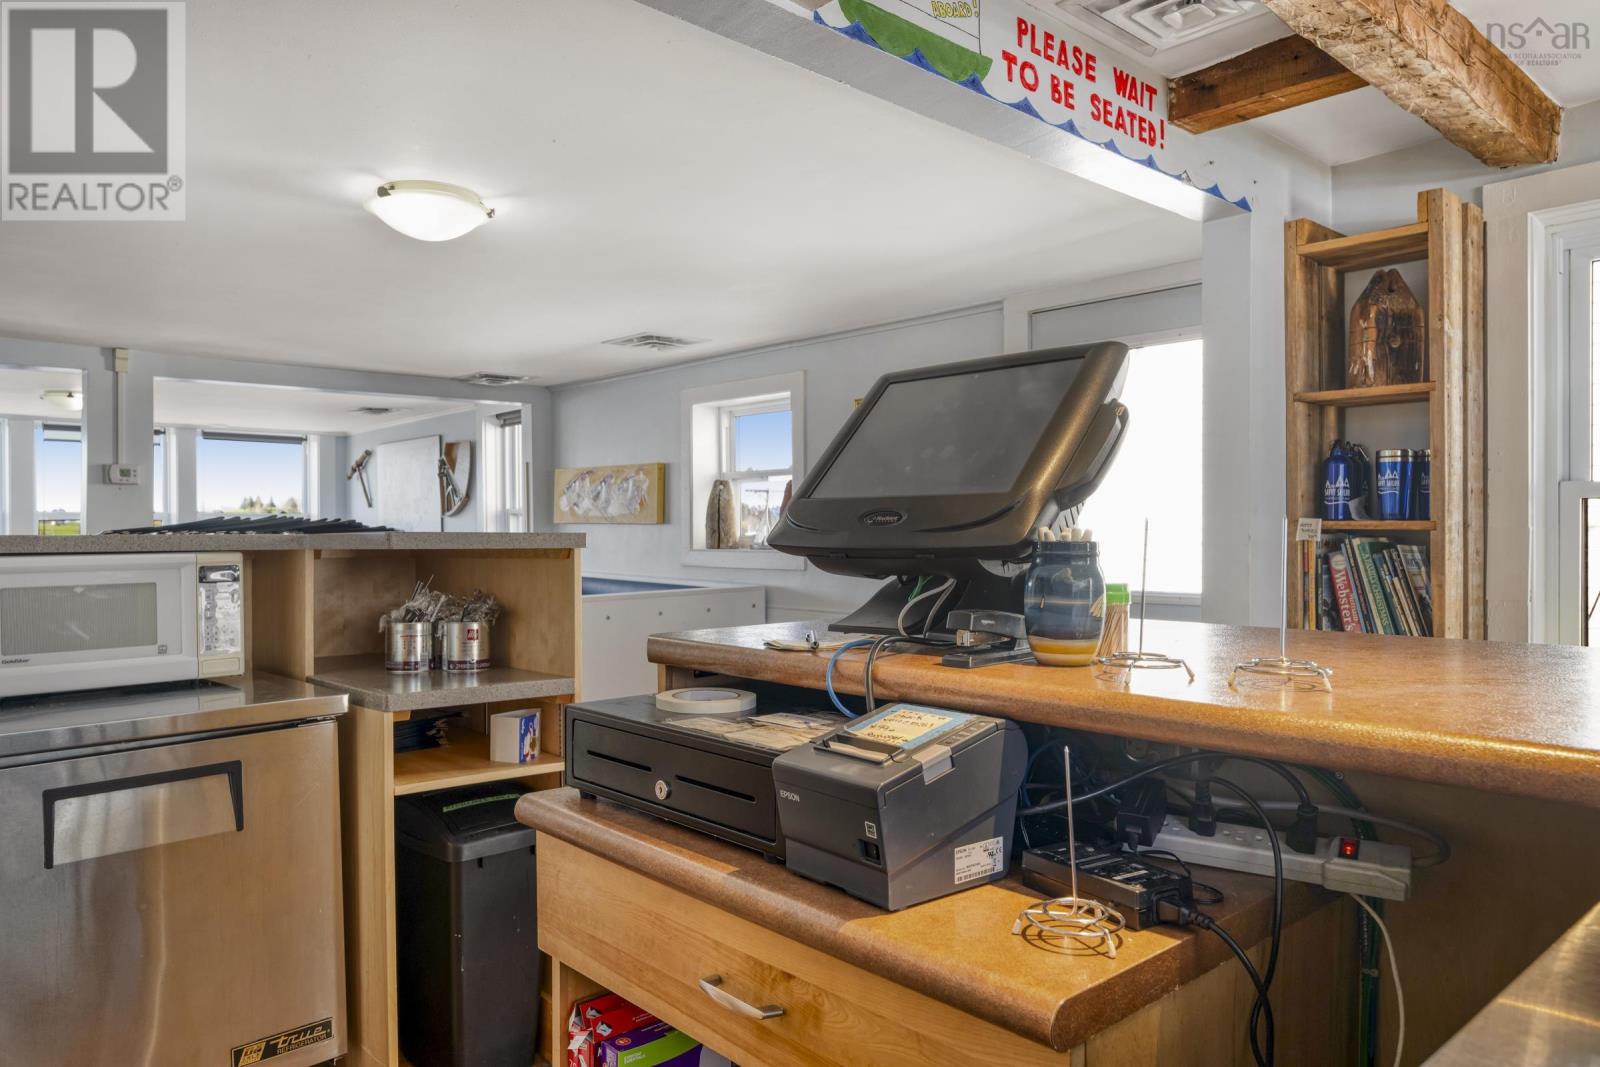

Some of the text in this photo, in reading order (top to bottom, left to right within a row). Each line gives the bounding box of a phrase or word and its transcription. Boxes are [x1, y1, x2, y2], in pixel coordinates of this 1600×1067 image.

[1001, 49, 1165, 149] TO BE SEATED!
[1017, 16, 1158, 112] PLEASE WAIT
[1335, 570, 1357, 632] Webster's
[779, 789, 800, 802] EPSON
